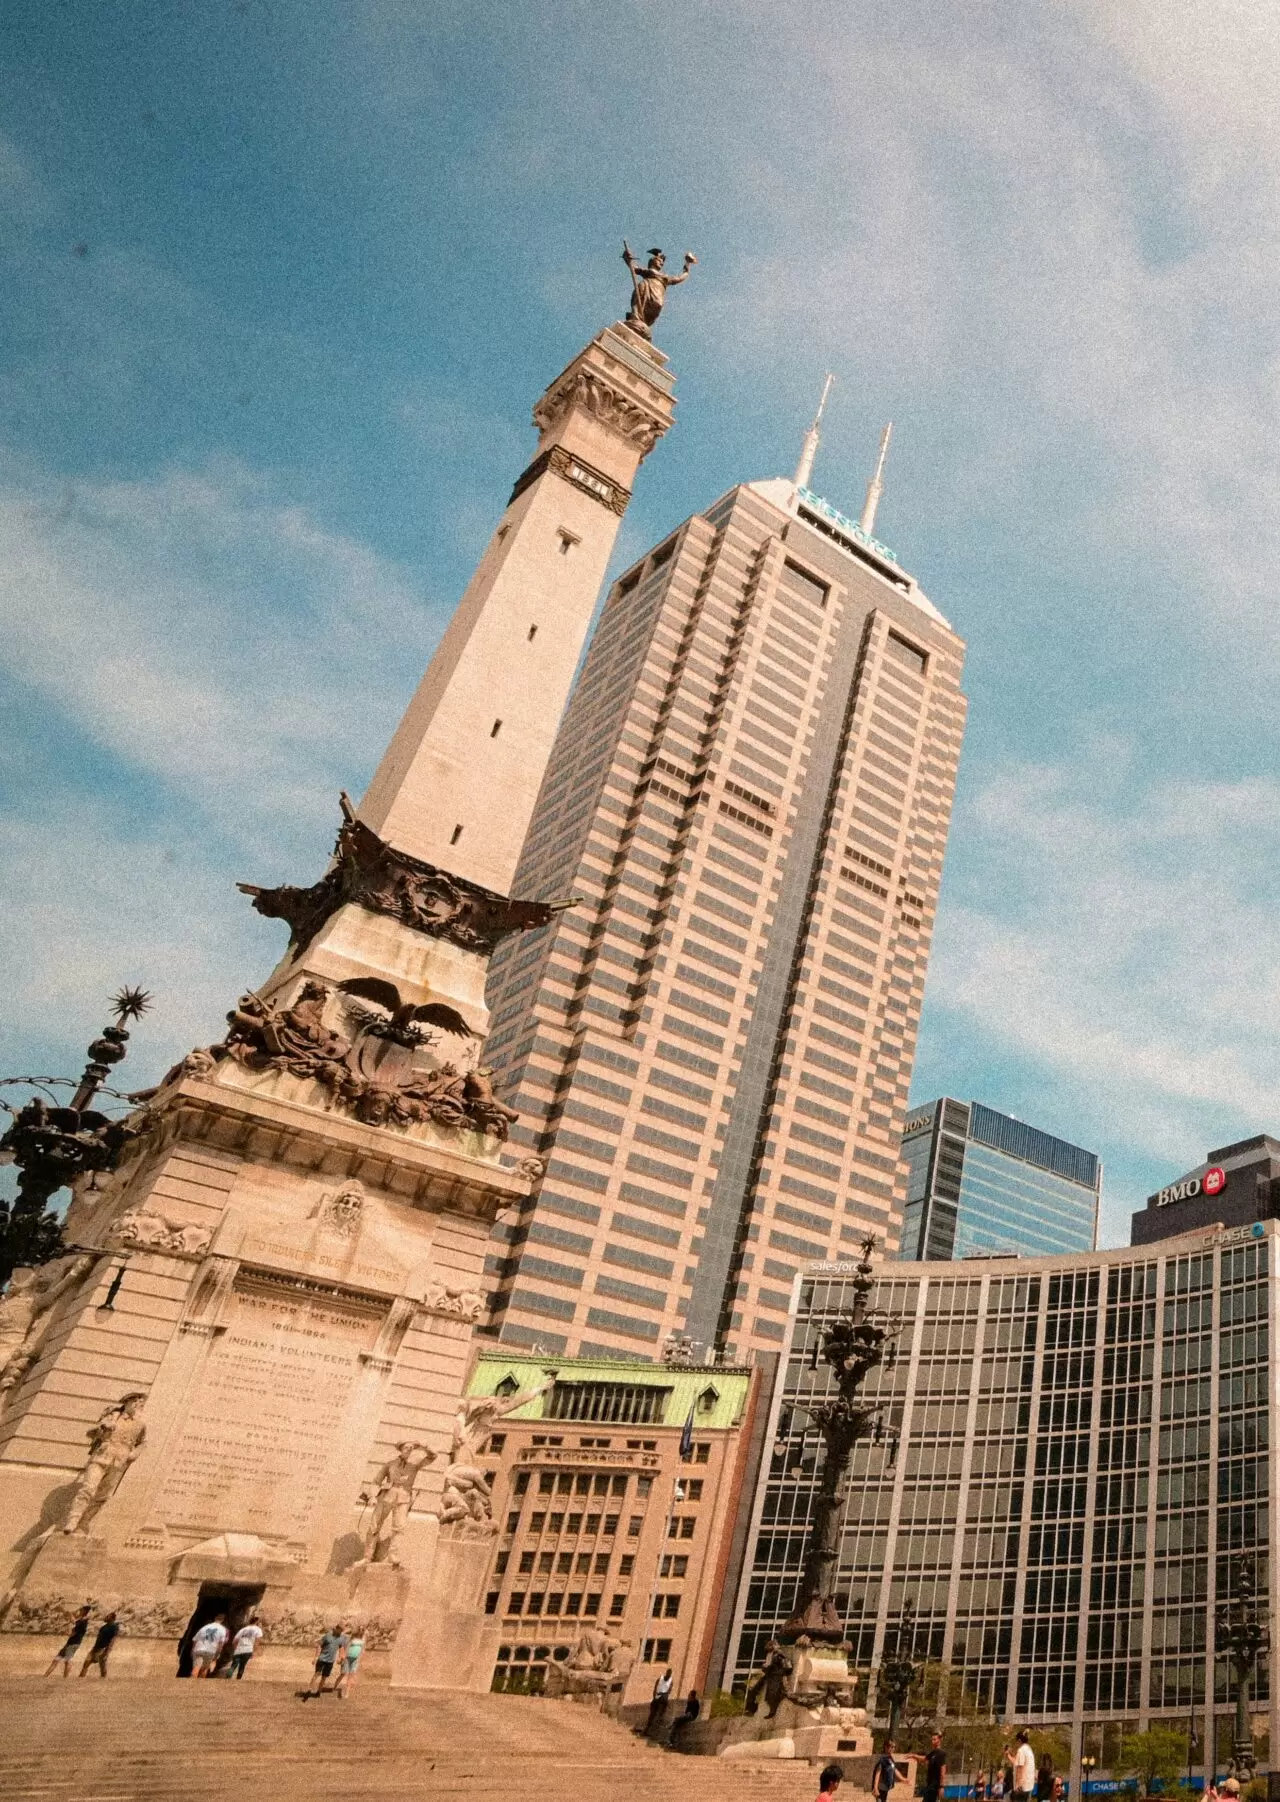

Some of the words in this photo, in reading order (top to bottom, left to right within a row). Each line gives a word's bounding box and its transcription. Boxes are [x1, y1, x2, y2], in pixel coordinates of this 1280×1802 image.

[1156, 1178, 1201, 1207] BMO
[1202, 1227, 1250, 1247] CHASE
[238, 1296, 267, 1310] WAR
[271, 1304, 298, 1315] FOR
[330, 1317, 369, 1330] UNION
[1092, 1782, 1119, 1791] CHASE
